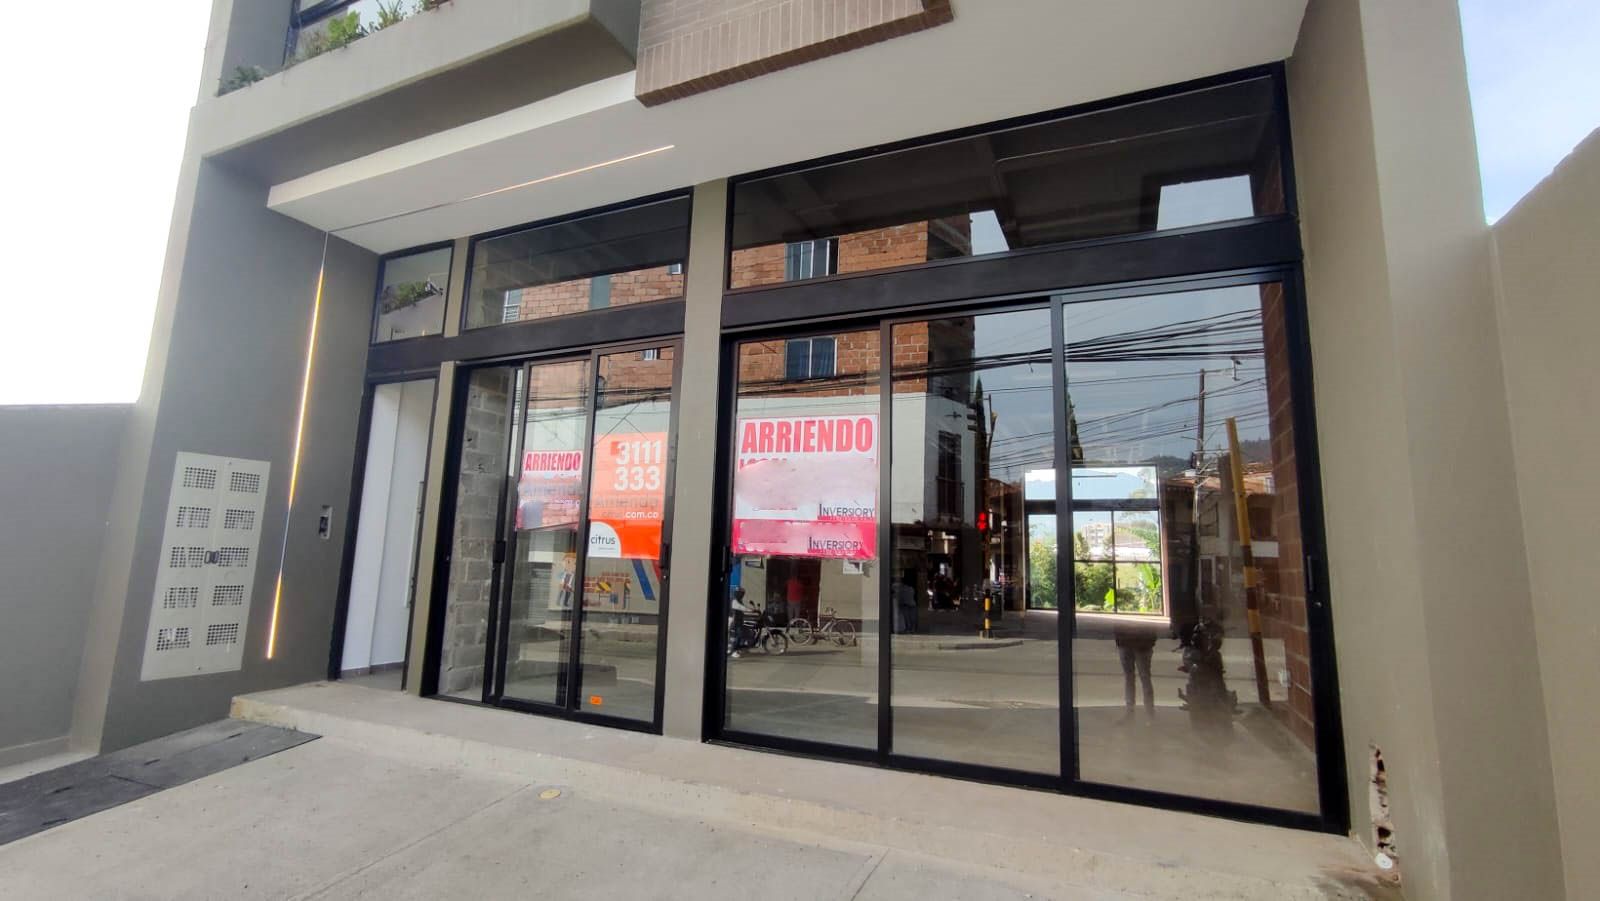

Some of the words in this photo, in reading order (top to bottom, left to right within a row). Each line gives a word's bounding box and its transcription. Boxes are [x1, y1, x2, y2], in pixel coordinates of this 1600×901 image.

[741, 418, 873, 453] ARRIENDO
[525, 452, 581, 471] ARRIENDO
[616, 440, 661, 465] 3111
[614, 465, 660, 491] 333
[590, 535, 616, 545] citrus
